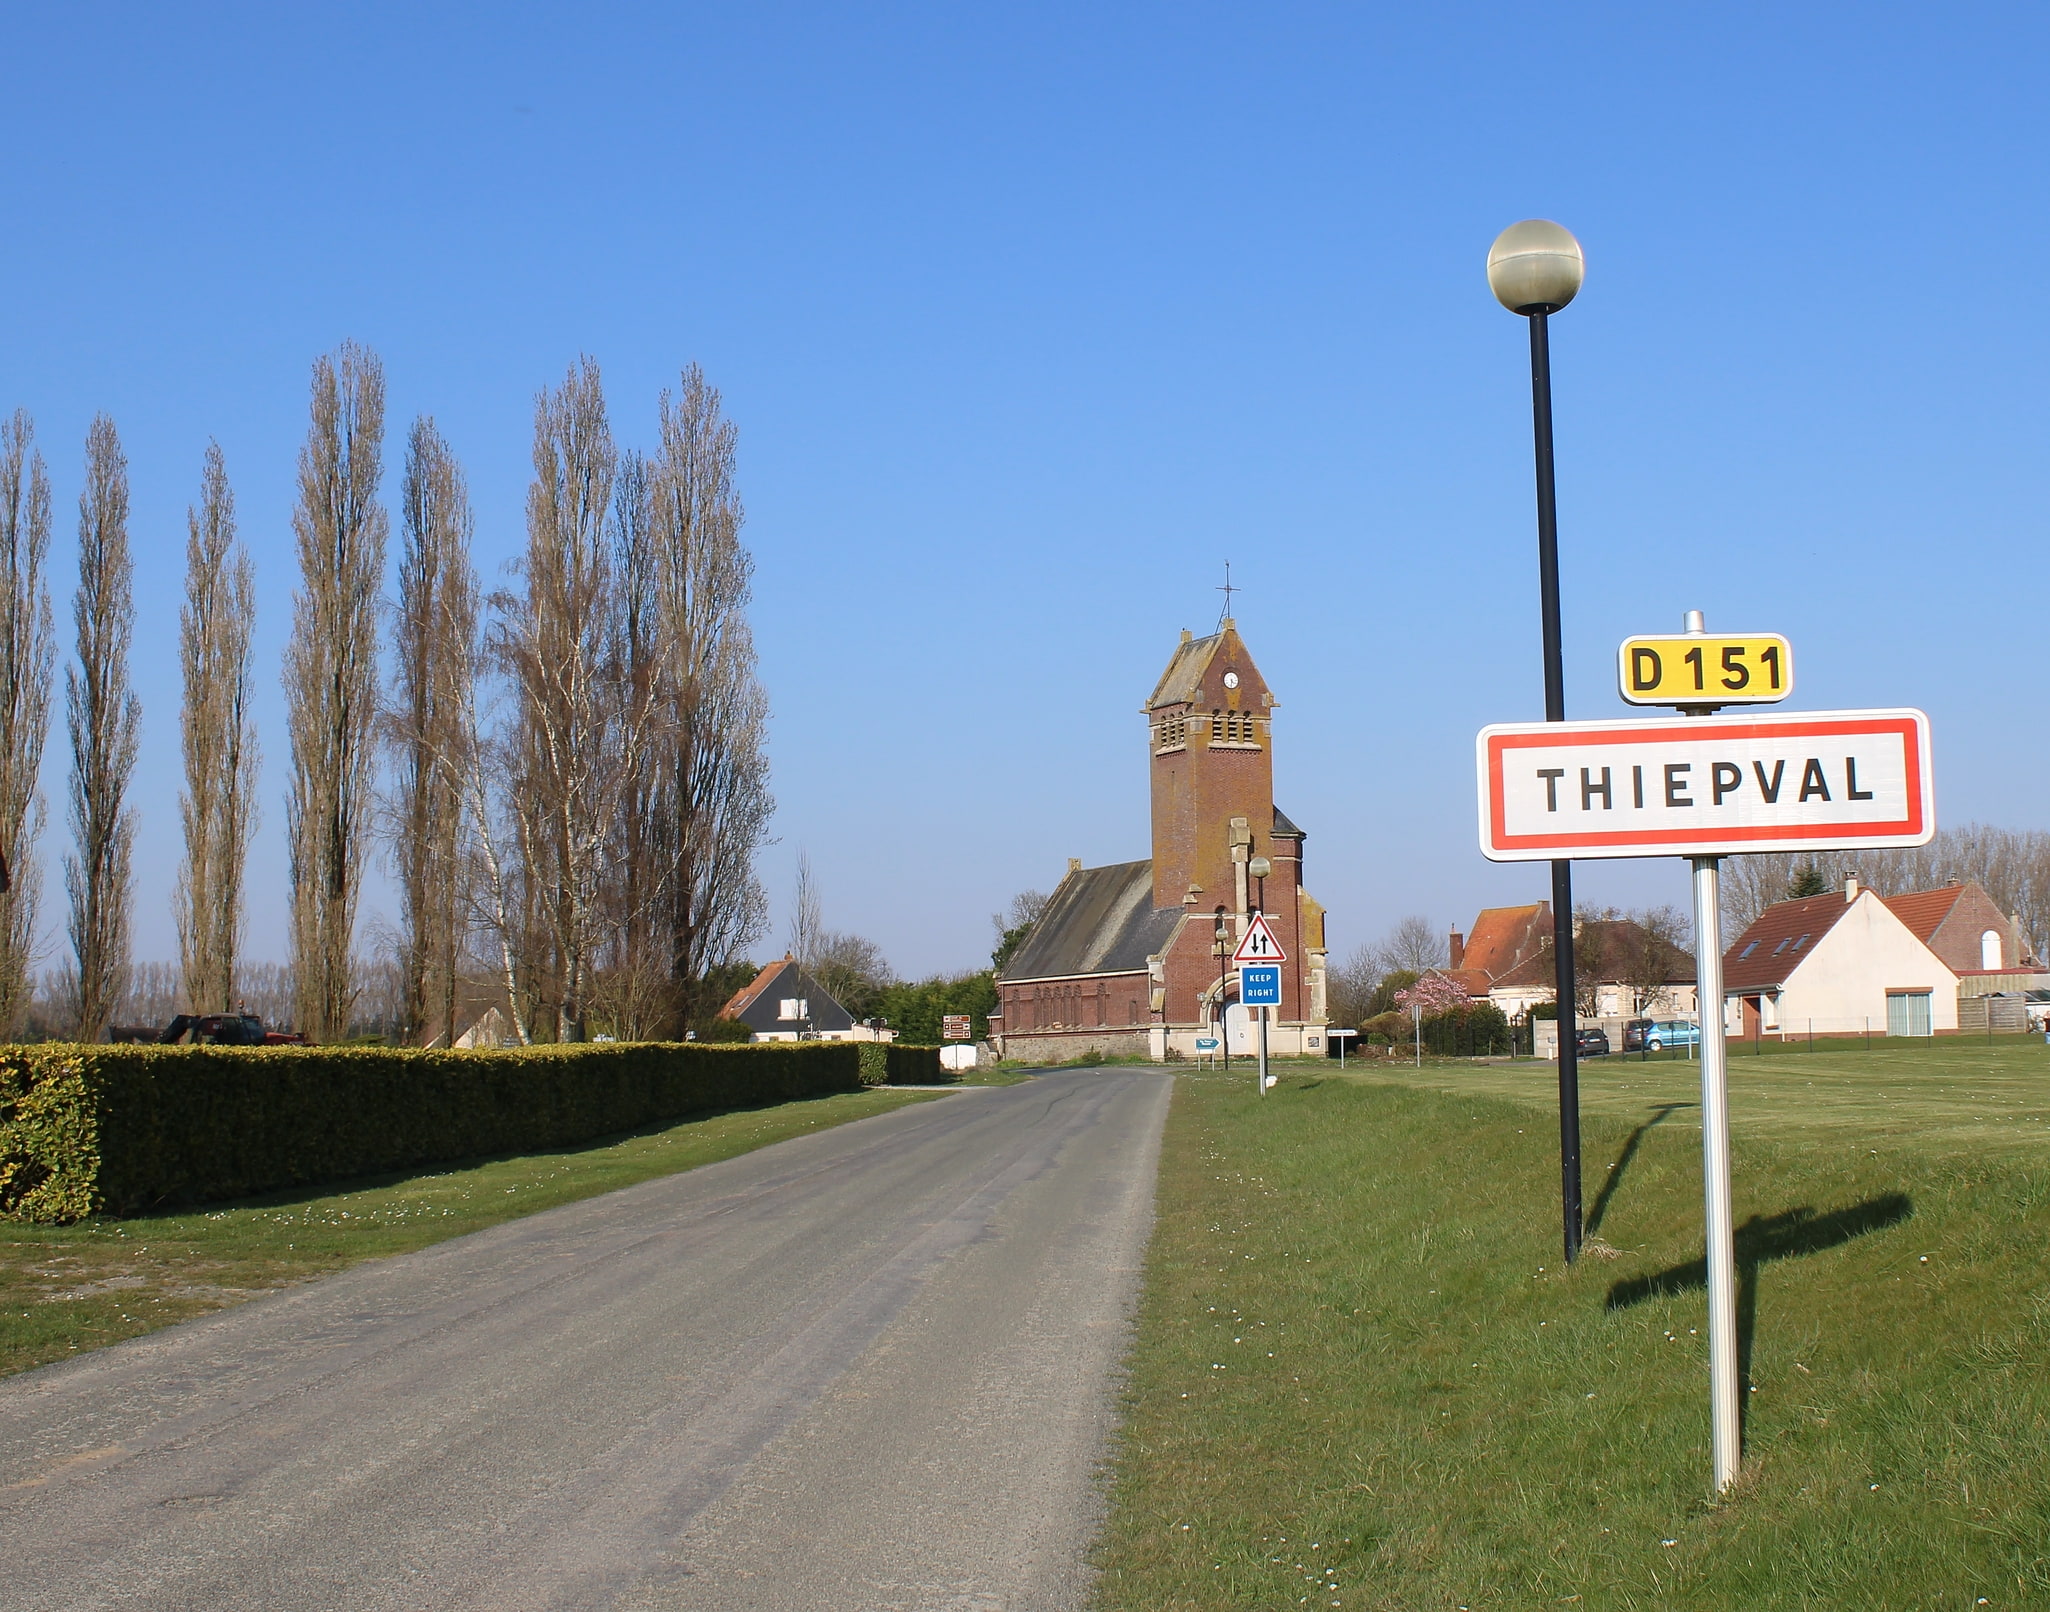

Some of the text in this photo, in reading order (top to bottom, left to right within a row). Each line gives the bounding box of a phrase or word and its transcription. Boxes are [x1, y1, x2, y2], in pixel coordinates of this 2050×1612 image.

[1631, 646, 1780, 691] D 151
[1537, 756, 1873, 812] THIEPVAL
[1249, 974, 1272, 982] KEEP
[1247, 988, 1274, 997] RIGHT
